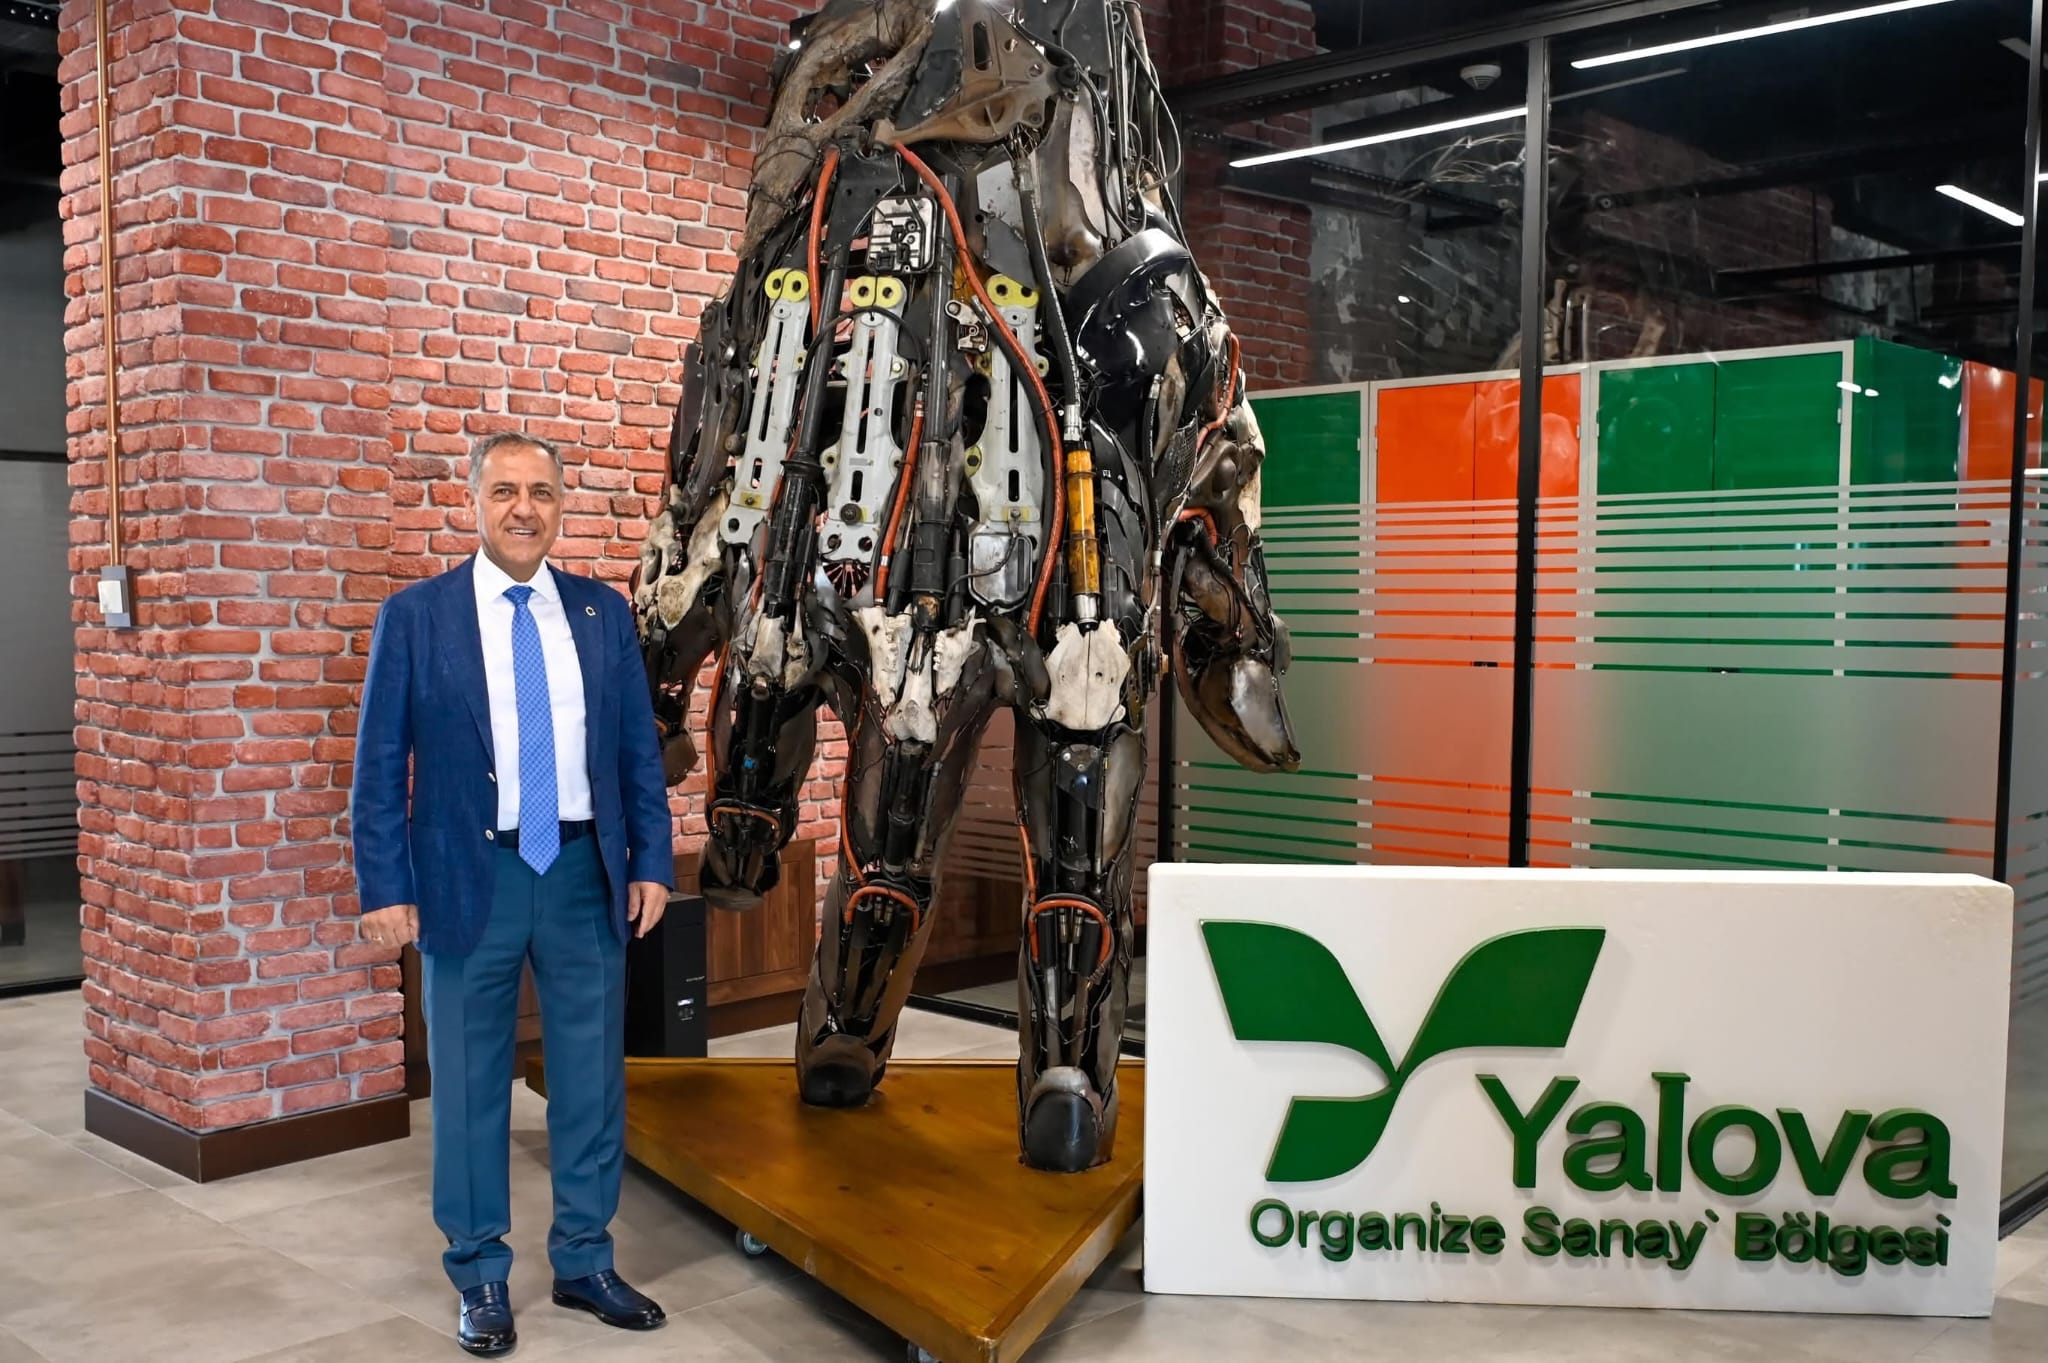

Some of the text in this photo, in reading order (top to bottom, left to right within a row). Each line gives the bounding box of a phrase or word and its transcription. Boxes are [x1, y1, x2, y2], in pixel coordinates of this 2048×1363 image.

[1475, 1072, 1959, 1200] Yalova
[1249, 1200, 1952, 1277] Organize Sanay Bölgesi
